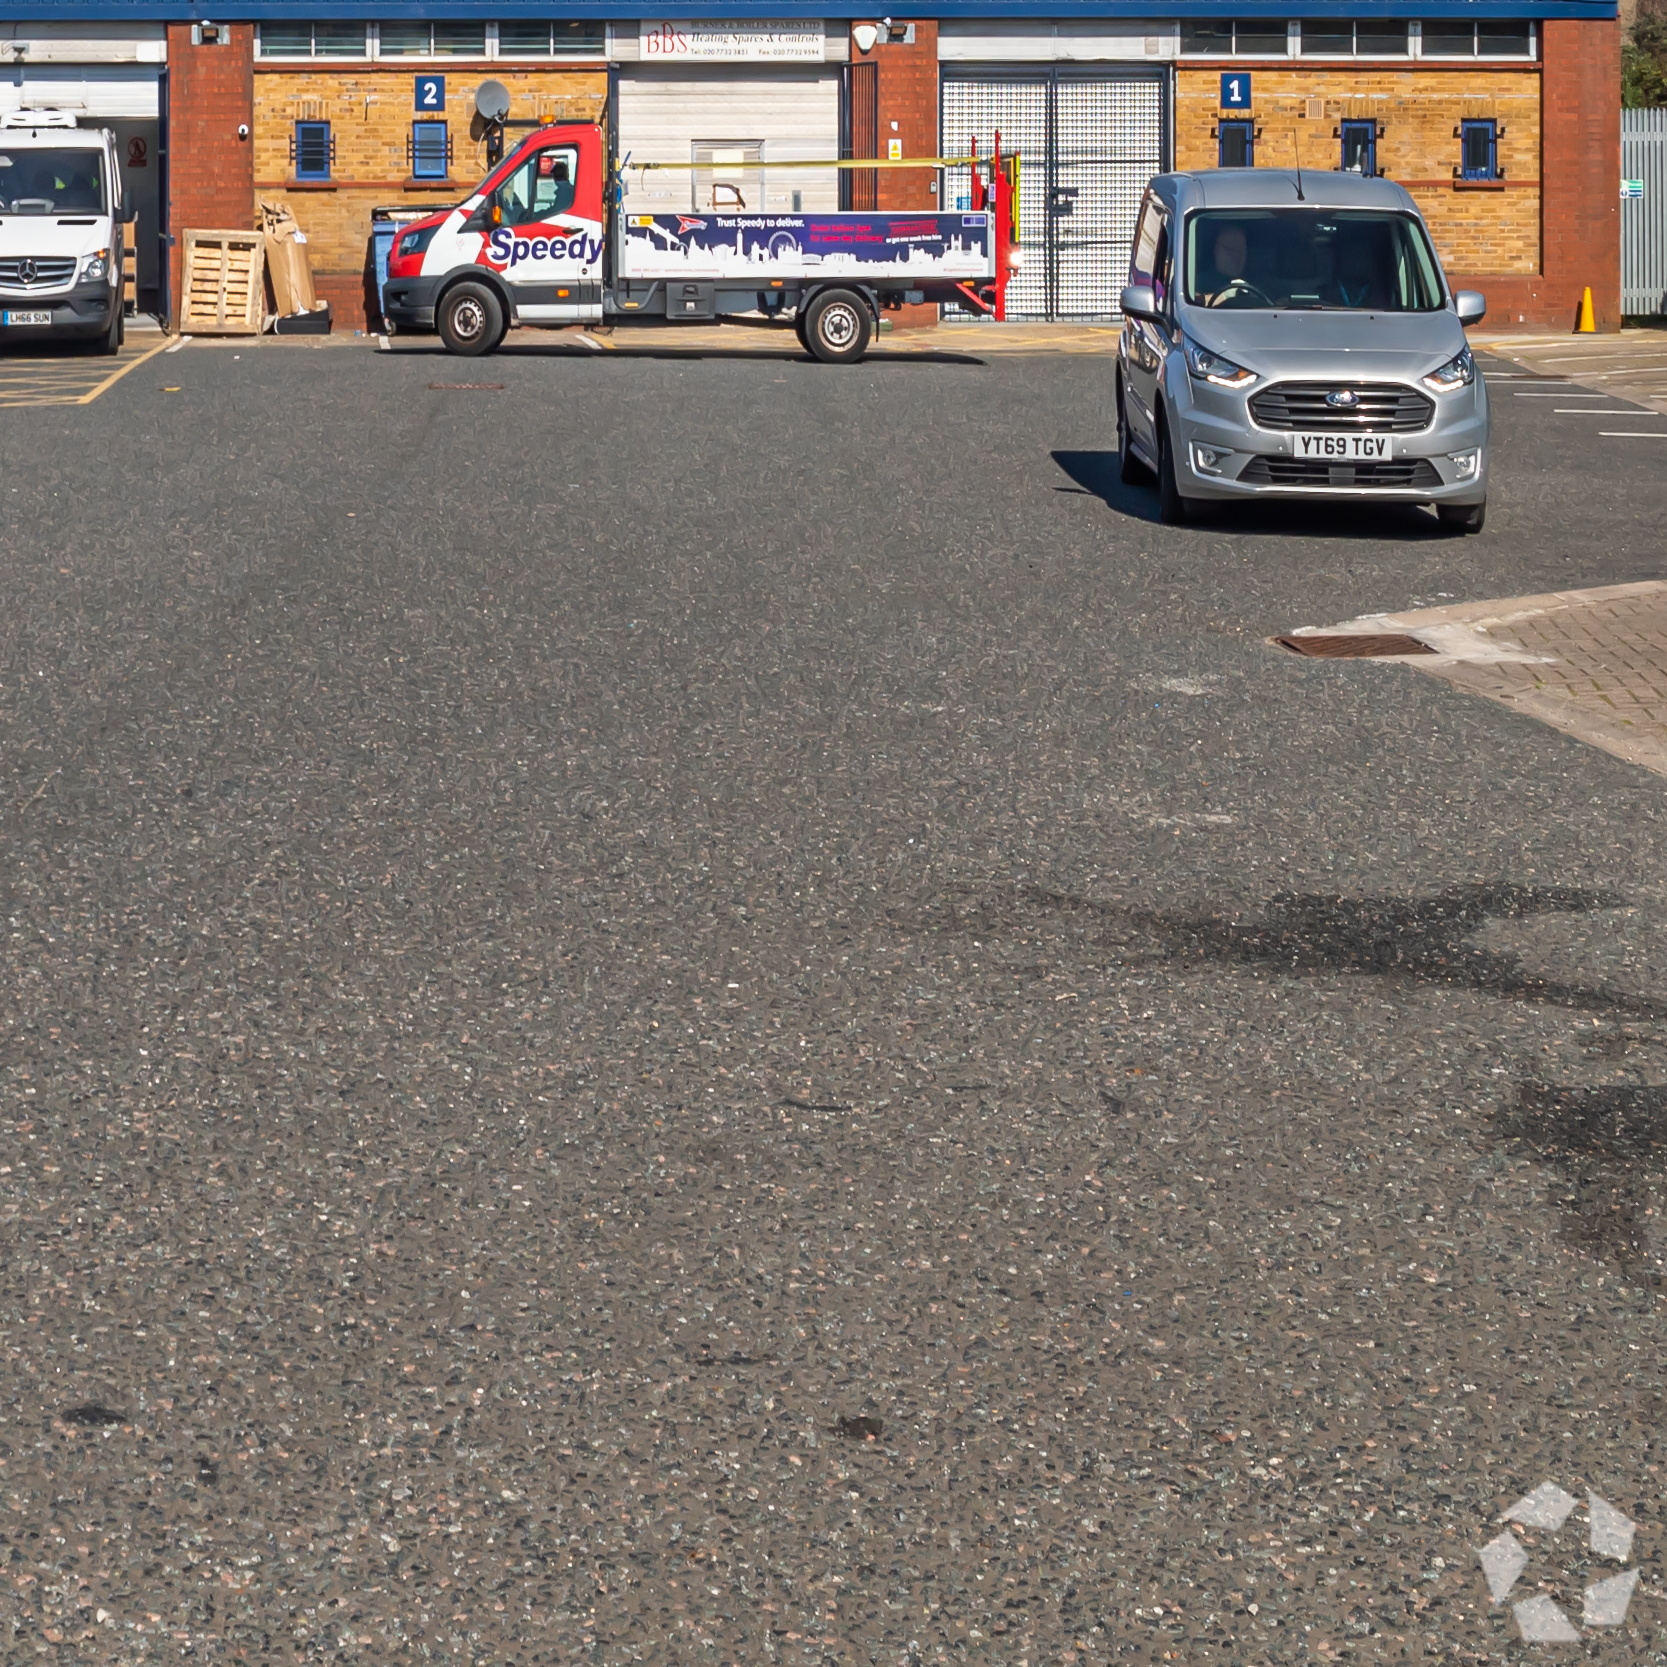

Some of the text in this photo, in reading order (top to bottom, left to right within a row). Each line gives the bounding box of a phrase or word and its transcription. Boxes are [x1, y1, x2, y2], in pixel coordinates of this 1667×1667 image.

[691, 21, 727, 29] BURNER
[736, 21, 767, 29] BOILER
[768, 21, 800, 29] SPARES
[801, 21, 820, 29] LTD
[647, 21, 687, 54] BBS
[691, 33, 819, 44] Heating Spares & Controls
[423, 82, 438, 104] 2
[1229, 80, 1242, 101] 1
[716, 217, 805, 230] Trust Speedy to deliver.
[841, 235, 853, 243] day
[855, 235, 883, 243] delivery
[491, 228, 603, 267] Speedy
[10, 313, 50, 323] LH66 SUN
[1301, 436, 1386, 456] YT69 TGV
